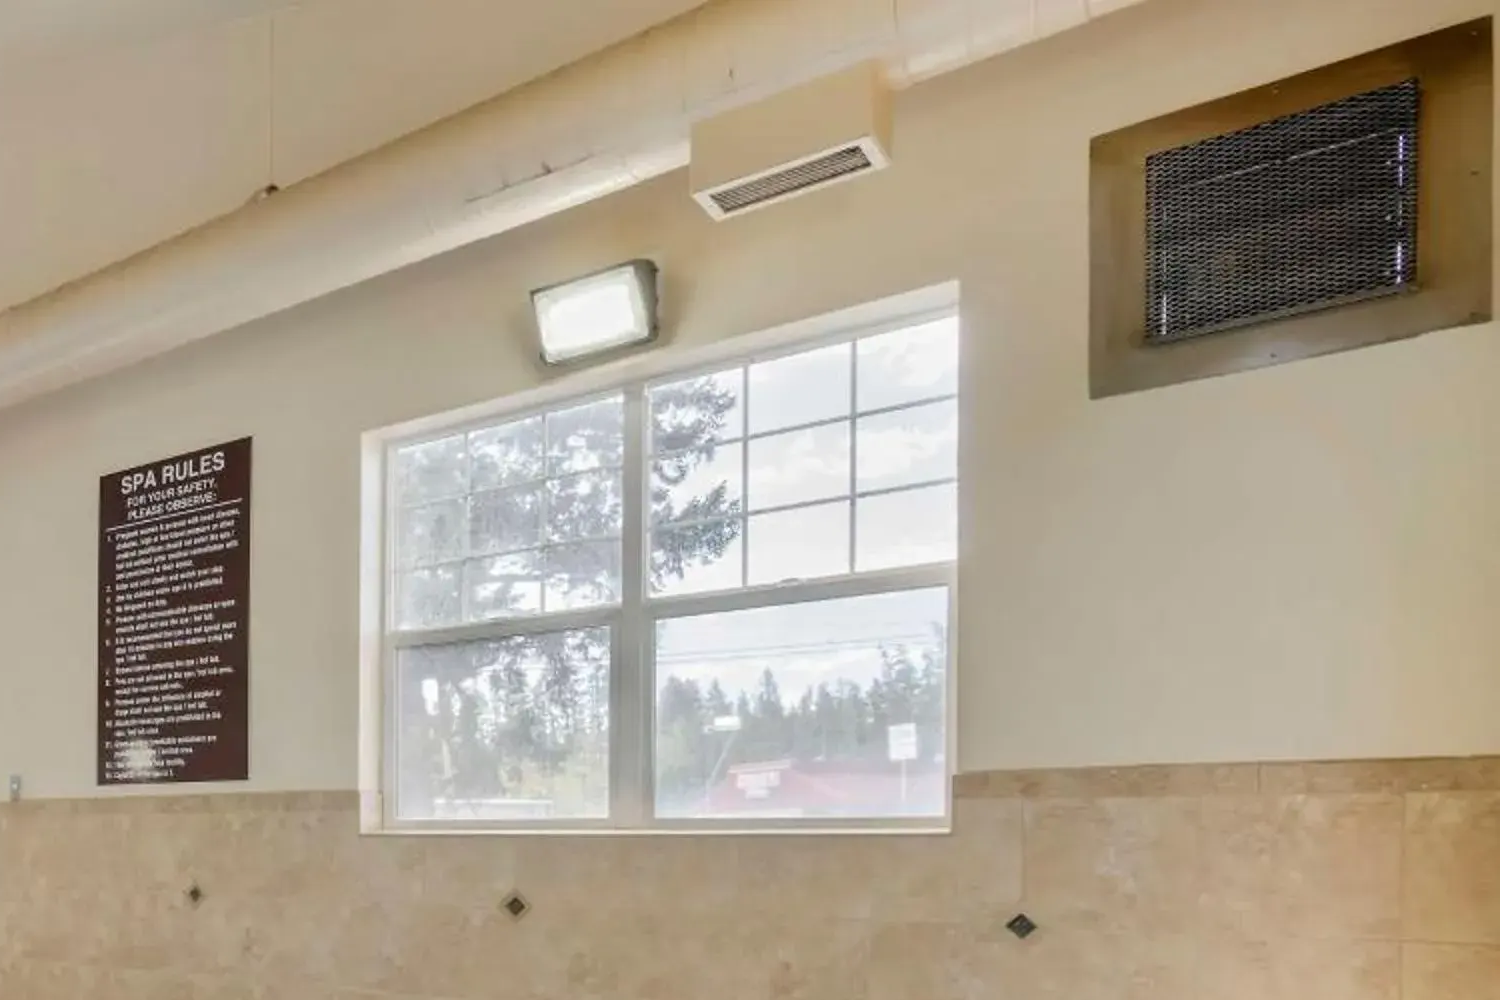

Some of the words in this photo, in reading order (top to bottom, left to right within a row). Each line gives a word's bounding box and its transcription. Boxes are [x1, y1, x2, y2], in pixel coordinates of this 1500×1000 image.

[121, 470, 157, 495] SPA
[162, 451, 225, 485] RULES
[127, 494, 147, 508] FOR
[148, 487, 175, 503] YOUR
[128, 503, 165, 520] PLEASE
